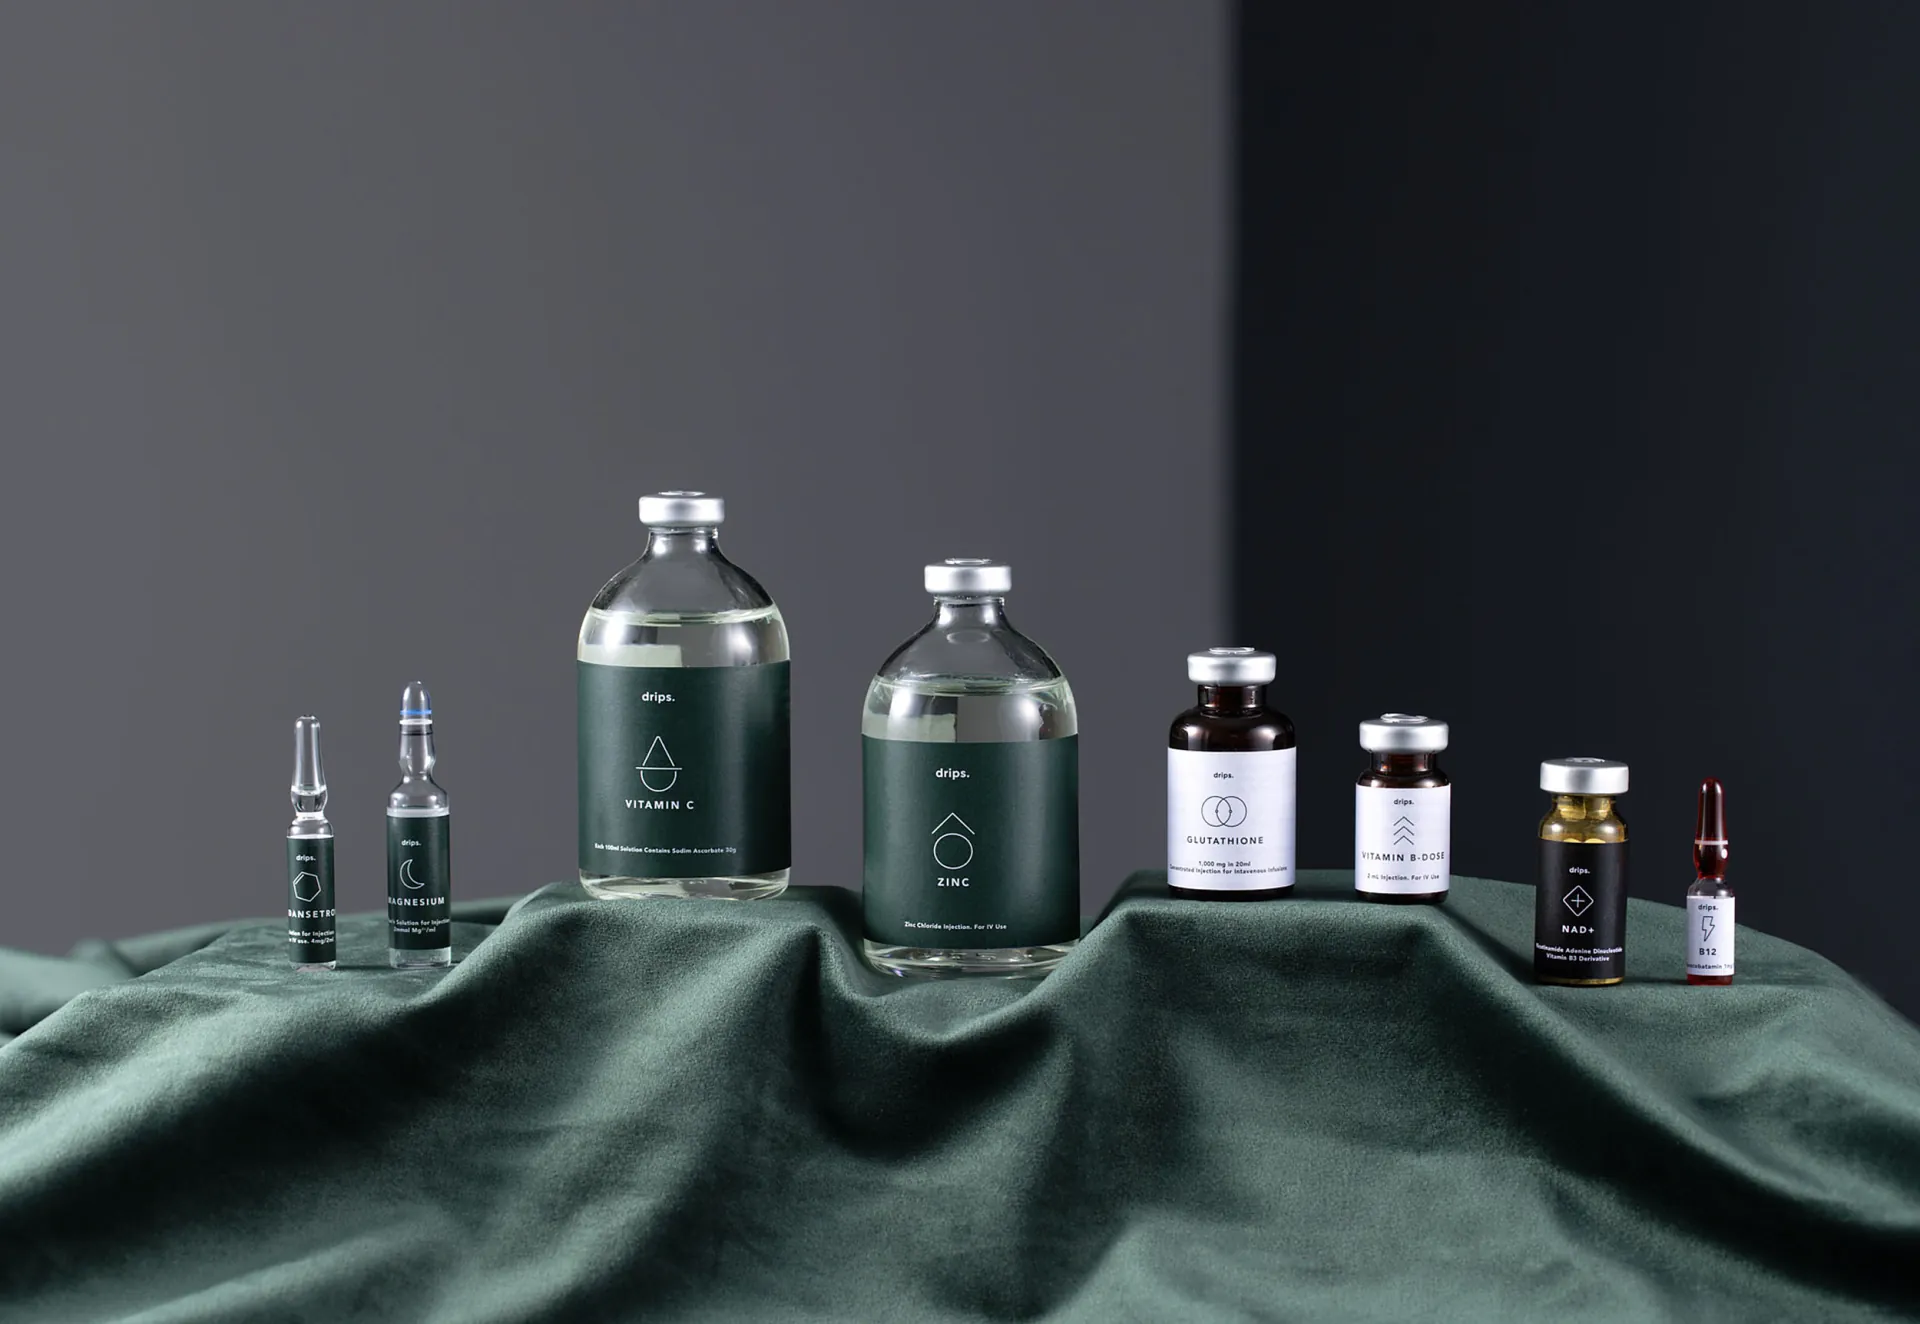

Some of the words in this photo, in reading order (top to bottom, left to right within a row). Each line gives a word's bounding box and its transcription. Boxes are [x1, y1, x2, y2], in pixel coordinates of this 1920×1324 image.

[642, 692, 676, 704] drips.
[936, 768, 970, 780] drips.
[1213, 772, 1234, 780] drips.
[625, 799, 680, 809] VITAMIN
[686, 801, 694, 810] C
[1186, 836, 1264, 845] GLUTATHIONE
[1362, 852, 1404, 861] VITAMIN
[1410, 852, 1444, 861] B-DOSE
[1569, 867, 1590, 875] drips.
[937, 878, 969, 887] ZINC
[1562, 925, 1594, 934] NAD+
[1699, 947, 1716, 956] B12
